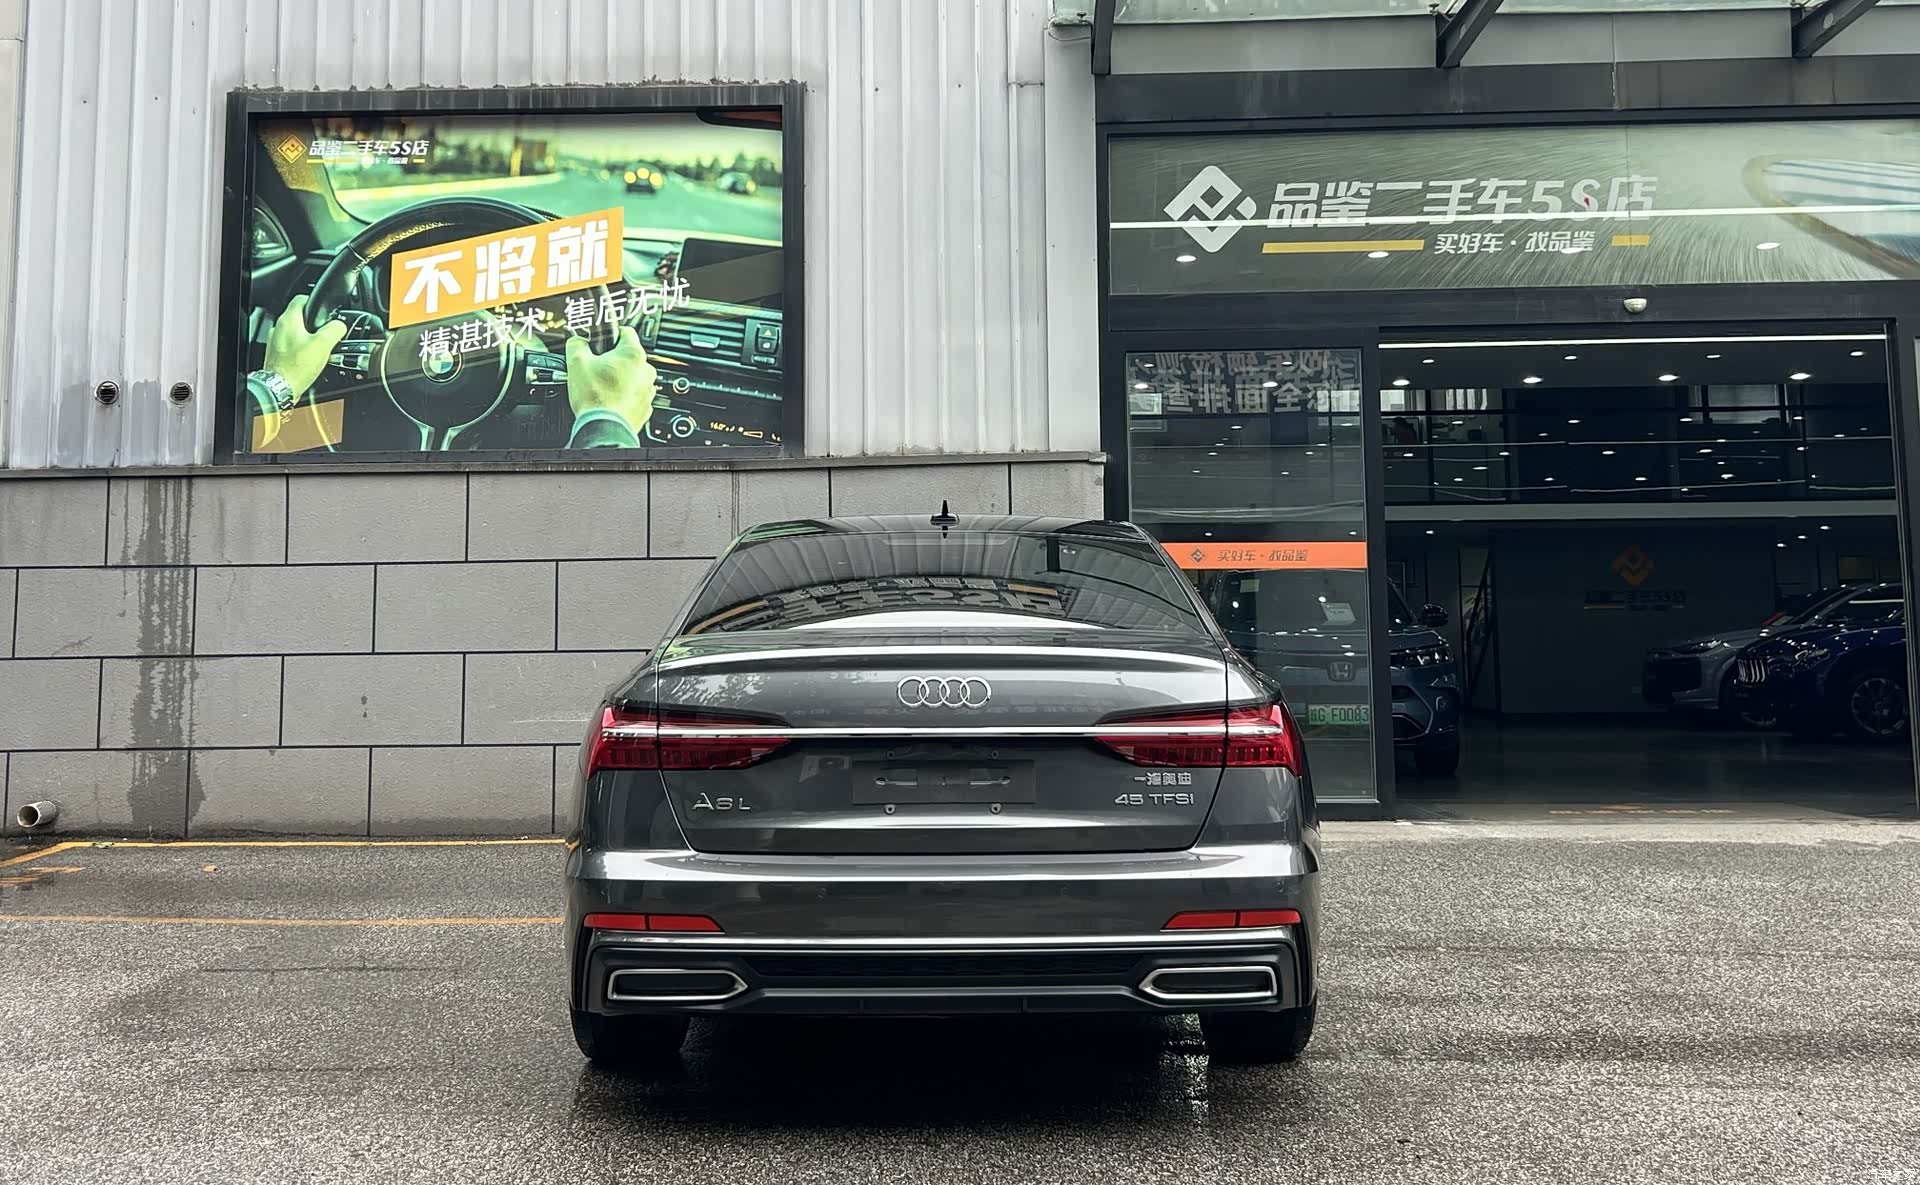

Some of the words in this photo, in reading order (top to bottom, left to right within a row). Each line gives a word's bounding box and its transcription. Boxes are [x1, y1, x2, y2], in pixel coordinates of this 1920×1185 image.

[308, 140, 429, 156] 品鉴二手车5S店
[1267, 176, 1659, 229] 品鉴二手车5S店
[402, 219, 609, 314] 不将就
[419, 307, 548, 361] 精湛技术
[564, 277, 692, 331] 售后无忧
[1133, 771, 1192, 786] 一汽奥迪
[1114, 793, 1144, 805] 45
[1148, 793, 1194, 805] TFSI
